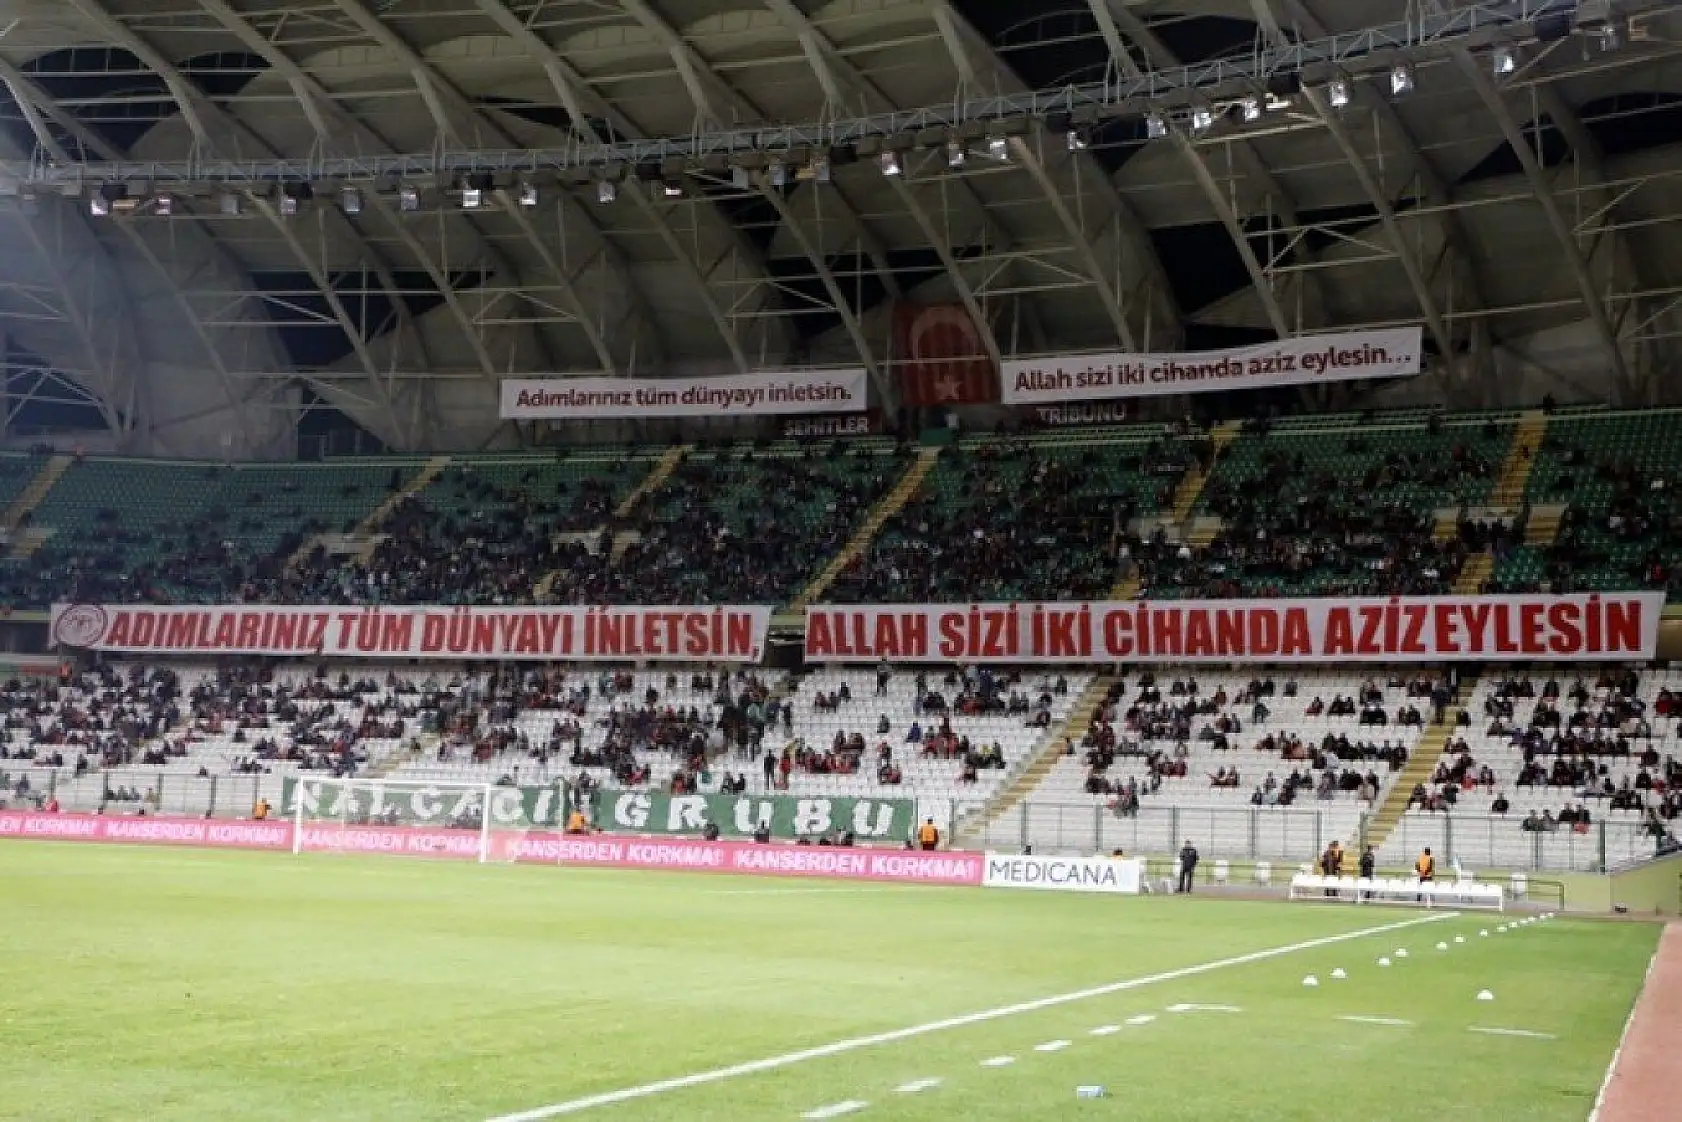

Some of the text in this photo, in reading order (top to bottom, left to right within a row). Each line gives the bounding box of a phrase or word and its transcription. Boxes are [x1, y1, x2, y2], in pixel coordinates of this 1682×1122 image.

[1014, 369, 1072, 392] Allah
[1076, 364, 1113, 387] sizi
[1118, 362, 1144, 384] iki
[1151, 357, 1242, 383] cihanda
[1247, 351, 1297, 375] aziz
[636, 384, 677, 405] tüm
[681, 383, 765, 410] dünyayı
[768, 380, 852, 402] inletsin.
[106, 611, 325, 649] ADIMLARINIZ
[339, 605, 414, 651] TÜM
[420, 607, 573, 652] DÜNYAYI
[585, 604, 759, 657] İNLETSİN,
[806, 594, 1642, 657] ALLAH SİZİ İKİ CİHANDA AZİZ EYLESİN
[614, 794, 893, 835] GRUBU
[627, 844, 724, 865] KORKMA!
[735, 850, 974, 879] KANSERDEN KORKMA!
[989, 860, 1117, 886] MEDICANA
